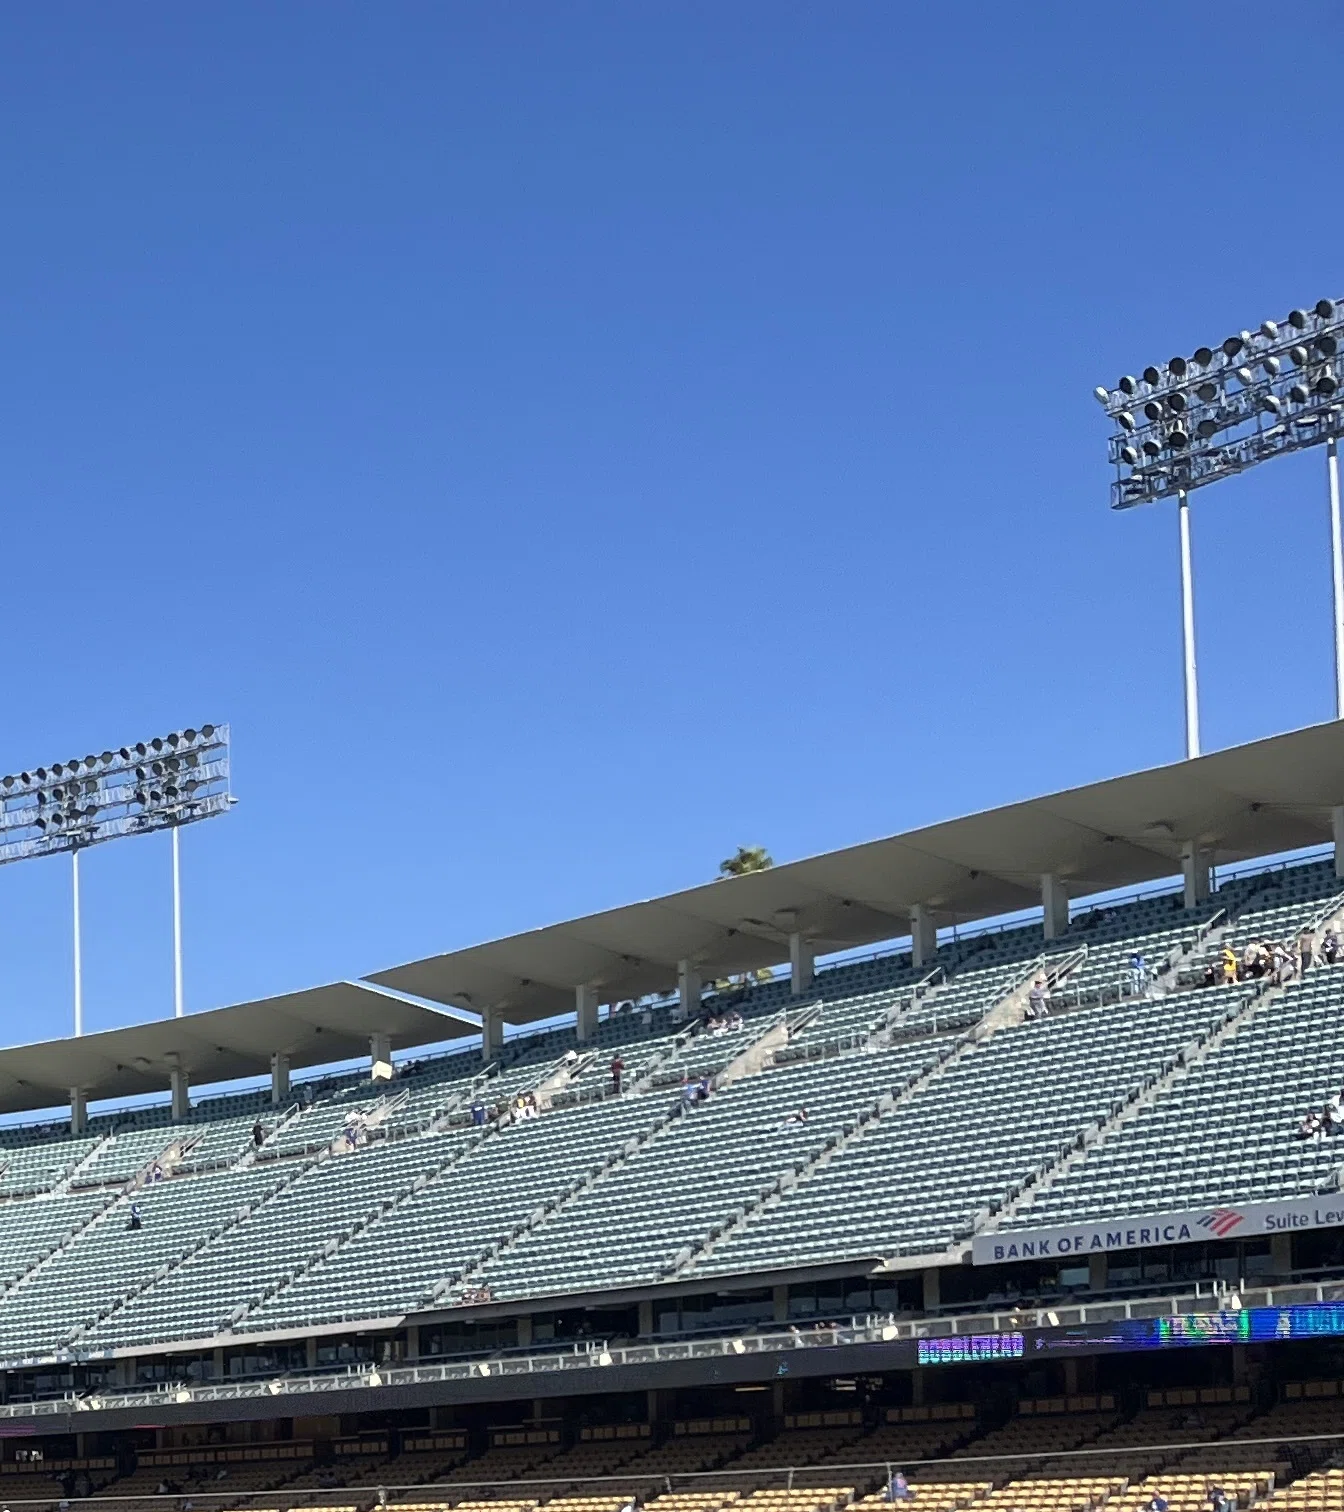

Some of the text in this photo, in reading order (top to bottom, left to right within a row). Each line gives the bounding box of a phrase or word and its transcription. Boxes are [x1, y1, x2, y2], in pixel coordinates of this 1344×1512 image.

[994, 1240, 1050, 1260] BANK
[1057, 1236, 1084, 1253] OF
[1090, 1224, 1191, 1249] AMERICA
[1266, 1213, 1309, 1231] Suite
